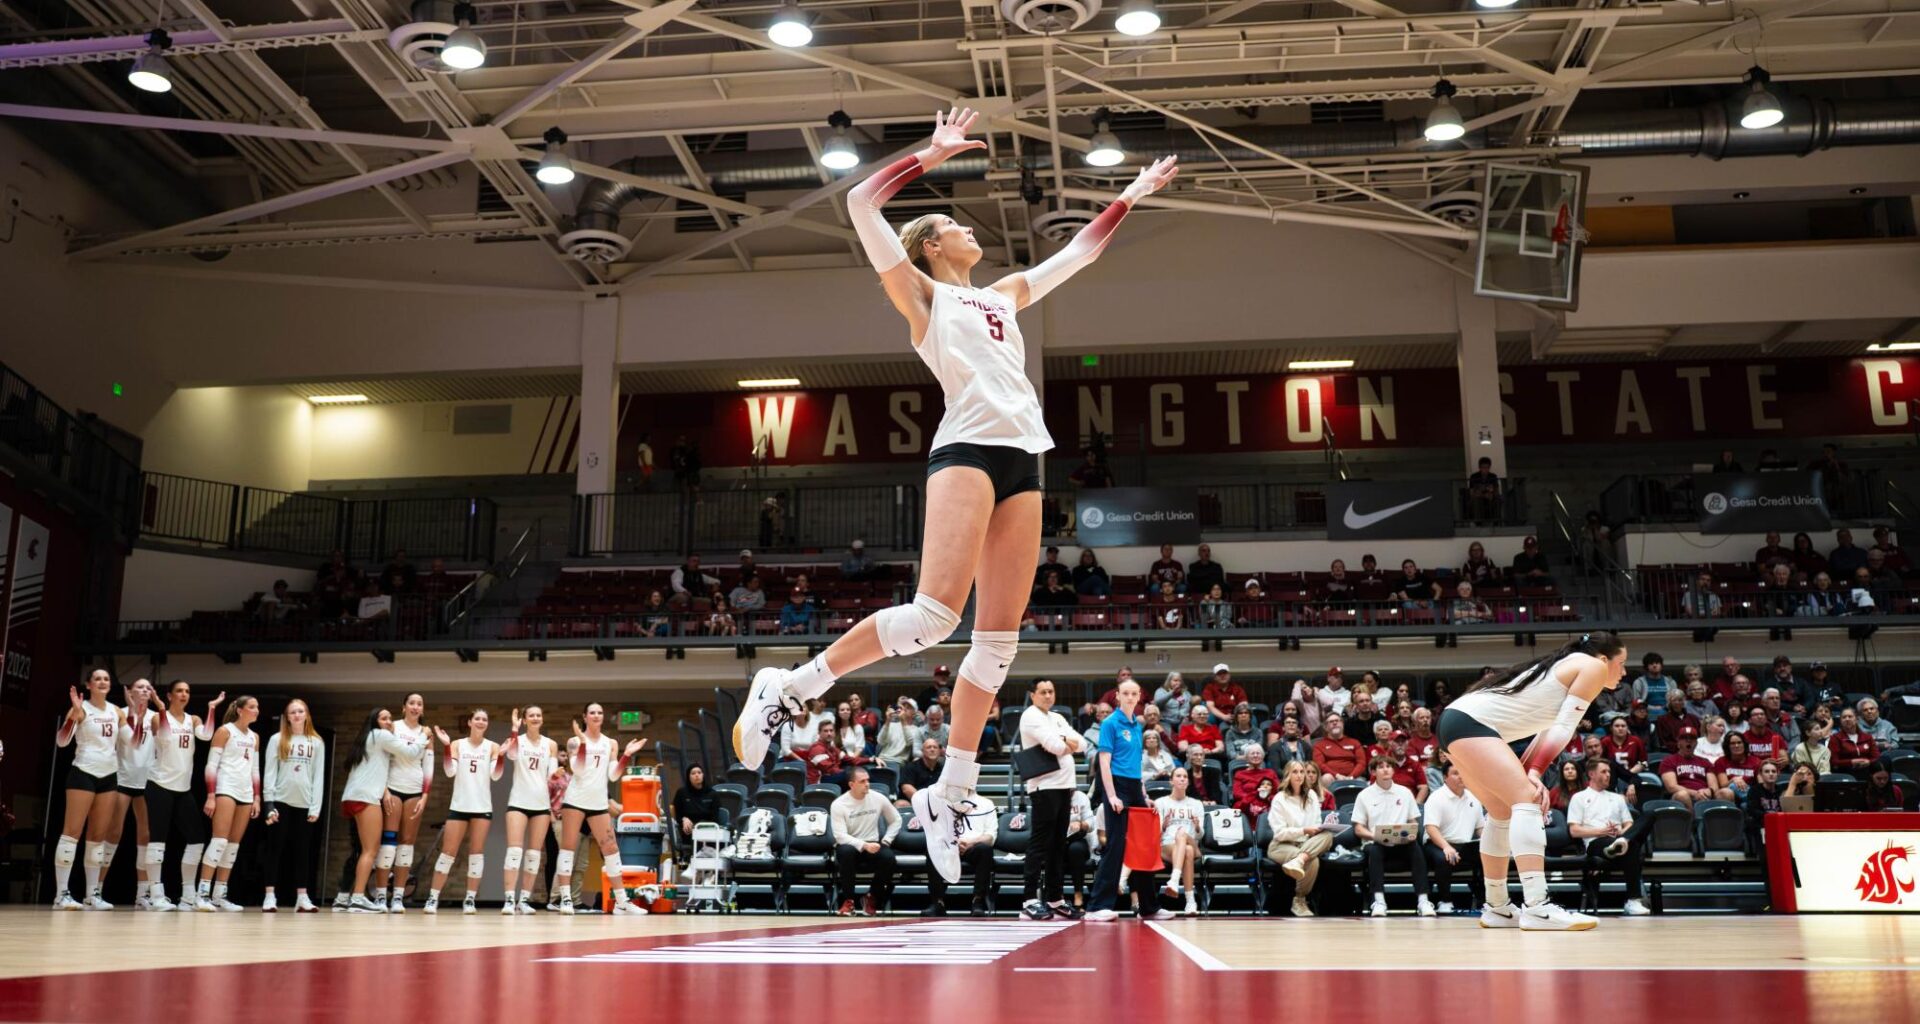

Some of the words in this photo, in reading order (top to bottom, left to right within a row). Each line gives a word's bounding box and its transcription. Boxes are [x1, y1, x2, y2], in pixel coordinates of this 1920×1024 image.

[744, 375, 1397, 459] WASNGTON
[1730, 496, 1757, 507] Gesa
[1758, 496, 1791, 507] Credit
[1793, 495, 1822, 505] Union
[1106, 511, 1131, 521] Gesa
[1133, 511, 1164, 521] Credit
[1166, 510, 1194, 520] Union
[7, 650, 31, 680] 2023
[101, 723, 113, 738] 13
[178, 735, 189, 749] 18
[469, 760, 477, 773] 5
[529, 757, 539, 770] 21
[593, 755, 601, 768] 7
[1615, 752, 1629, 769] 5
